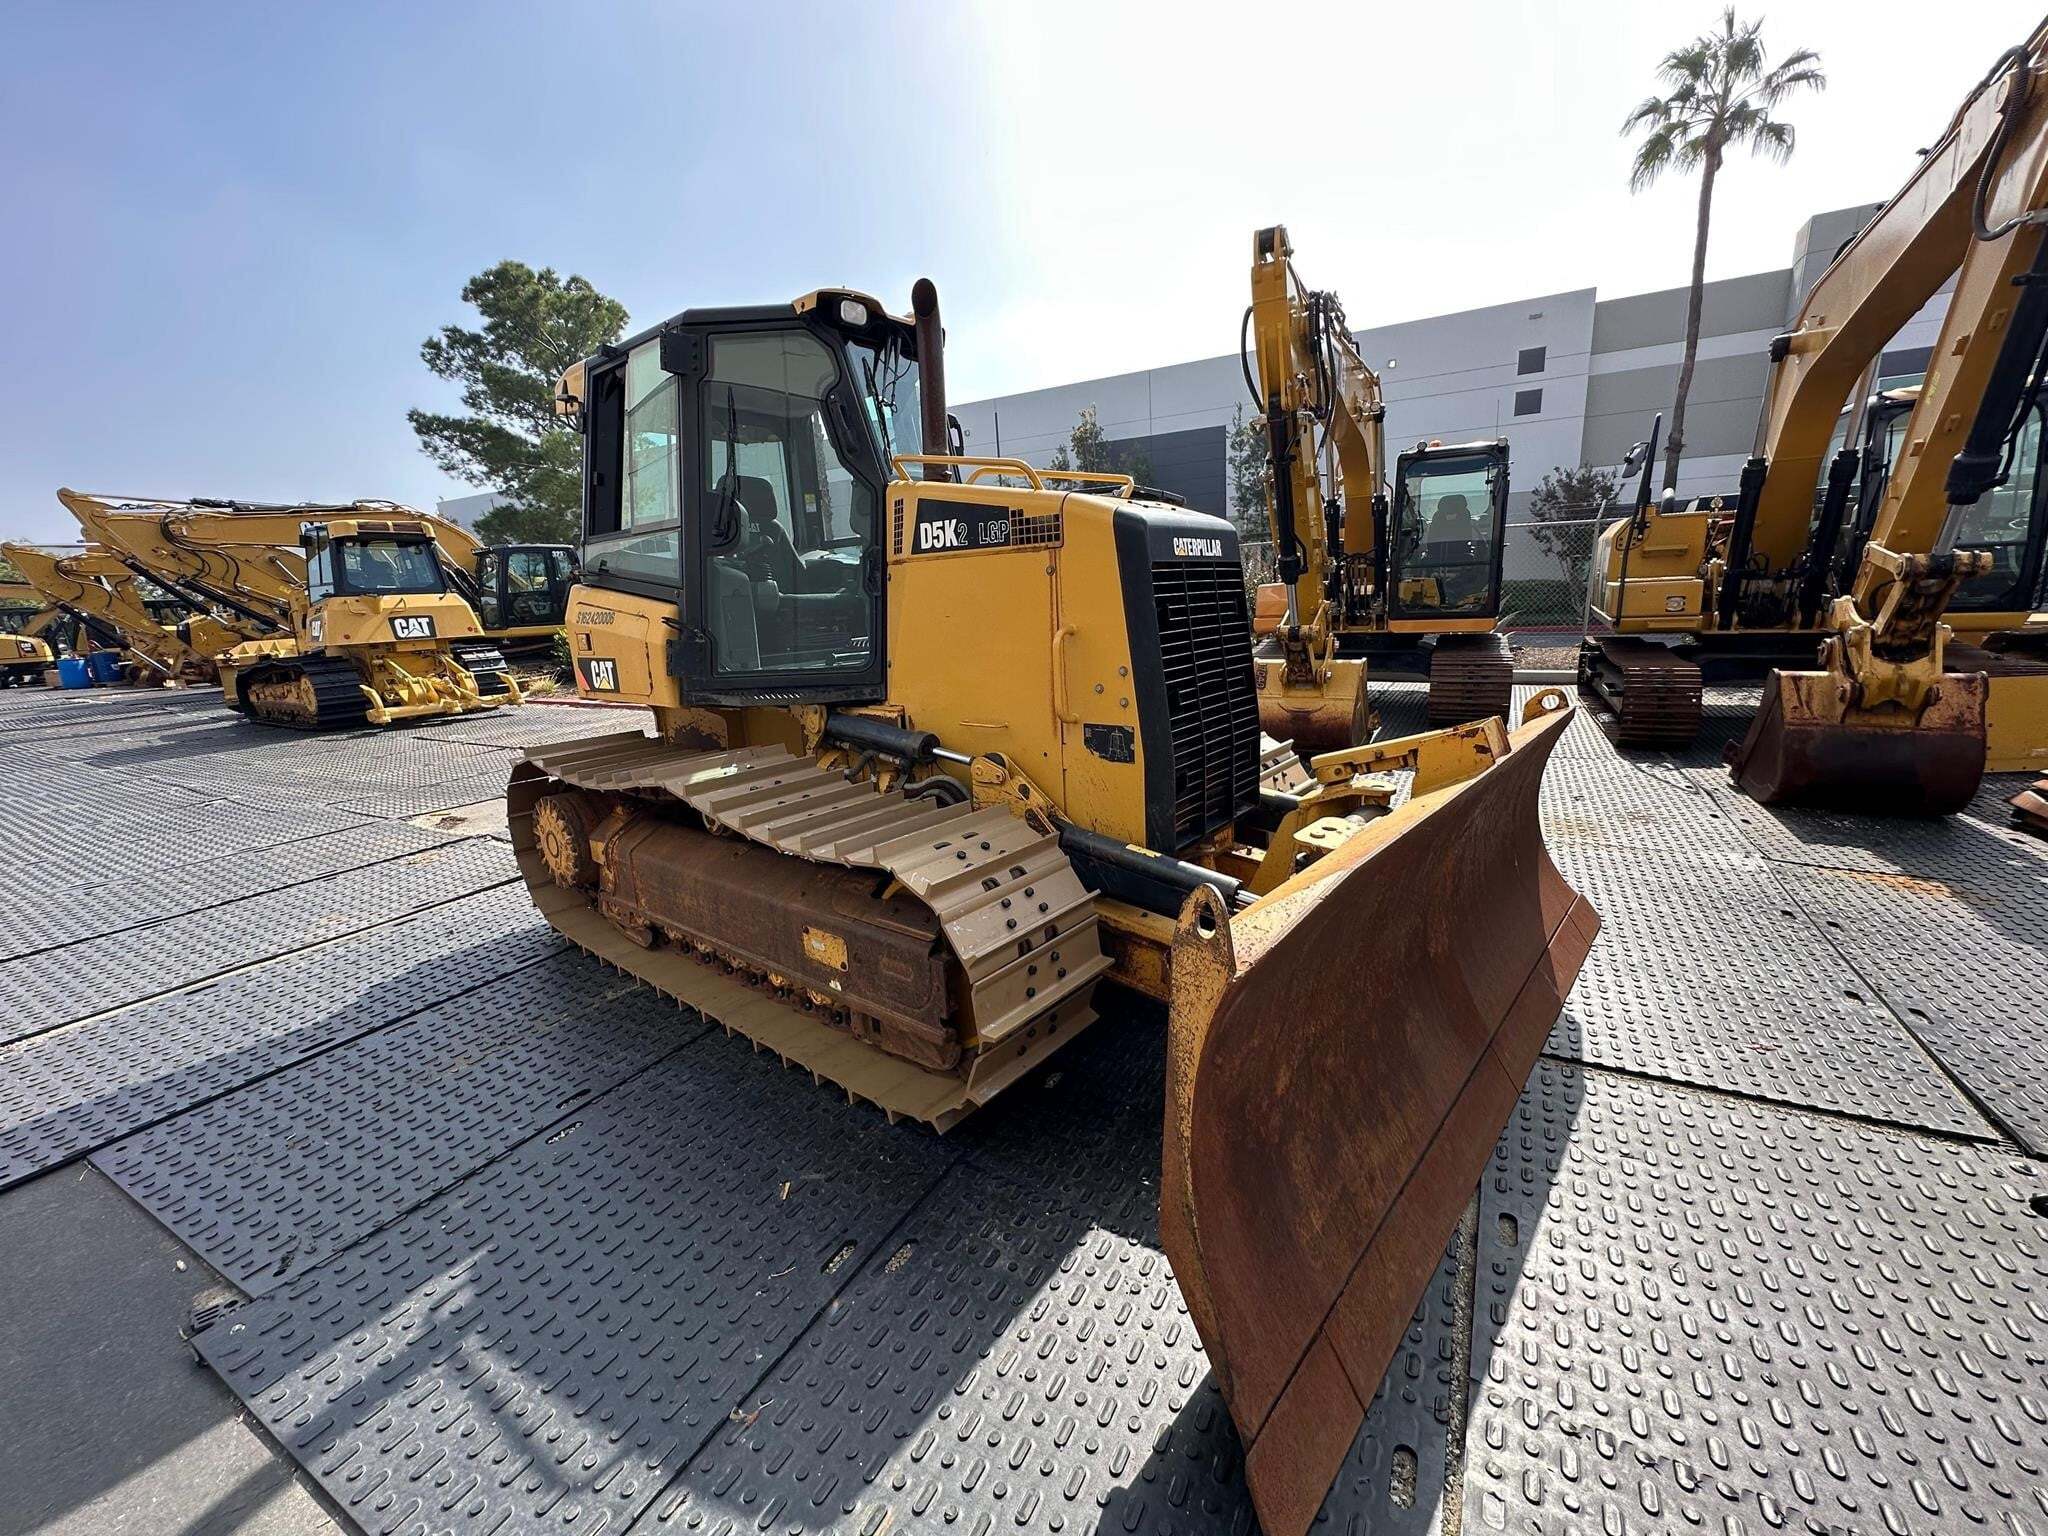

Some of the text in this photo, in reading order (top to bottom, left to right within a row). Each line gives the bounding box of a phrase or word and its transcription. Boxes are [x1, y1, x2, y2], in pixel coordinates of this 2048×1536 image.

[920, 518, 1010, 549] D5K2 LGP
[1173, 537, 1222, 556] CATERPILLAR
[393, 617, 430, 638] CAT
[590, 660, 615, 690] CAT
